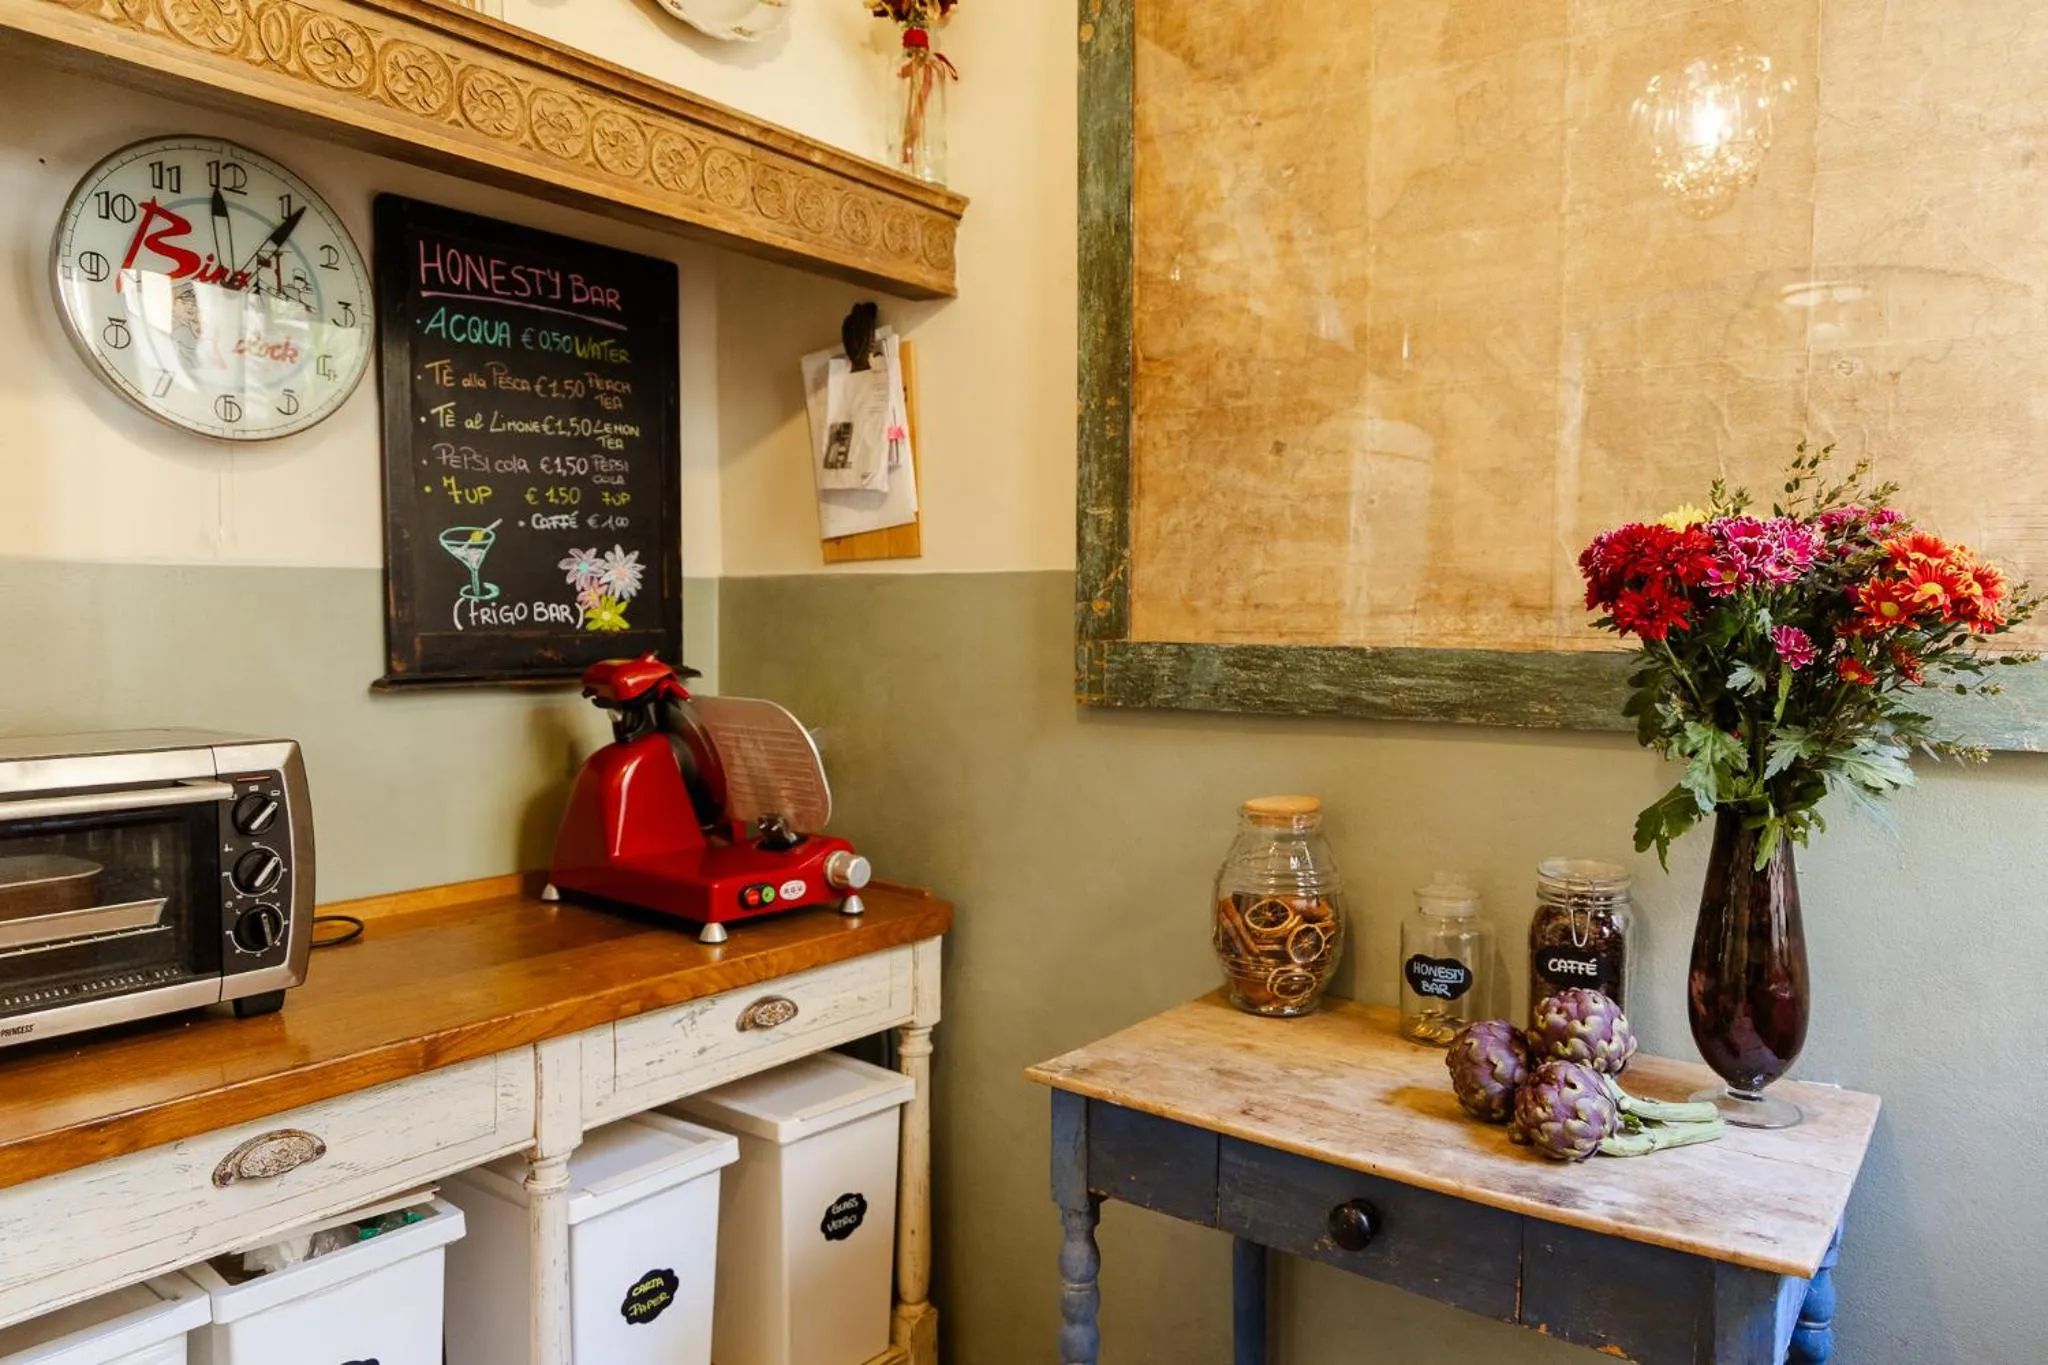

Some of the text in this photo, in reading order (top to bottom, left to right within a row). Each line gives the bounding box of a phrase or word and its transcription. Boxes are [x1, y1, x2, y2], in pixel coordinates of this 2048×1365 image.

[149, 160, 181, 194] 11
[206, 159, 247, 196] 12
[94, 190, 136, 224] 10
[279, 194, 293, 220] 1
[78, 250, 111, 282] 9
[319, 244, 340, 271] 2
[418, 239, 622, 312] HONESTY BAR
[331, 300, 356, 329] 3
[424, 306, 511, 349] ACQUA
[574, 336, 632, 364] WATER
[214, 393, 242, 423] 6
[276, 388, 300, 416] 5
[592, 419, 641, 437] LEMON
[595, 434, 625, 450] TEA
[432, 443, 491, 474] PEPSI
[591, 454, 629, 473] PEPSI
[442, 476, 493, 505] 7UP
[601, 492, 631, 507] 7UP
[1413, 961, 1465, 984] HONESTY
[1421, 980, 1451, 997] BAR
